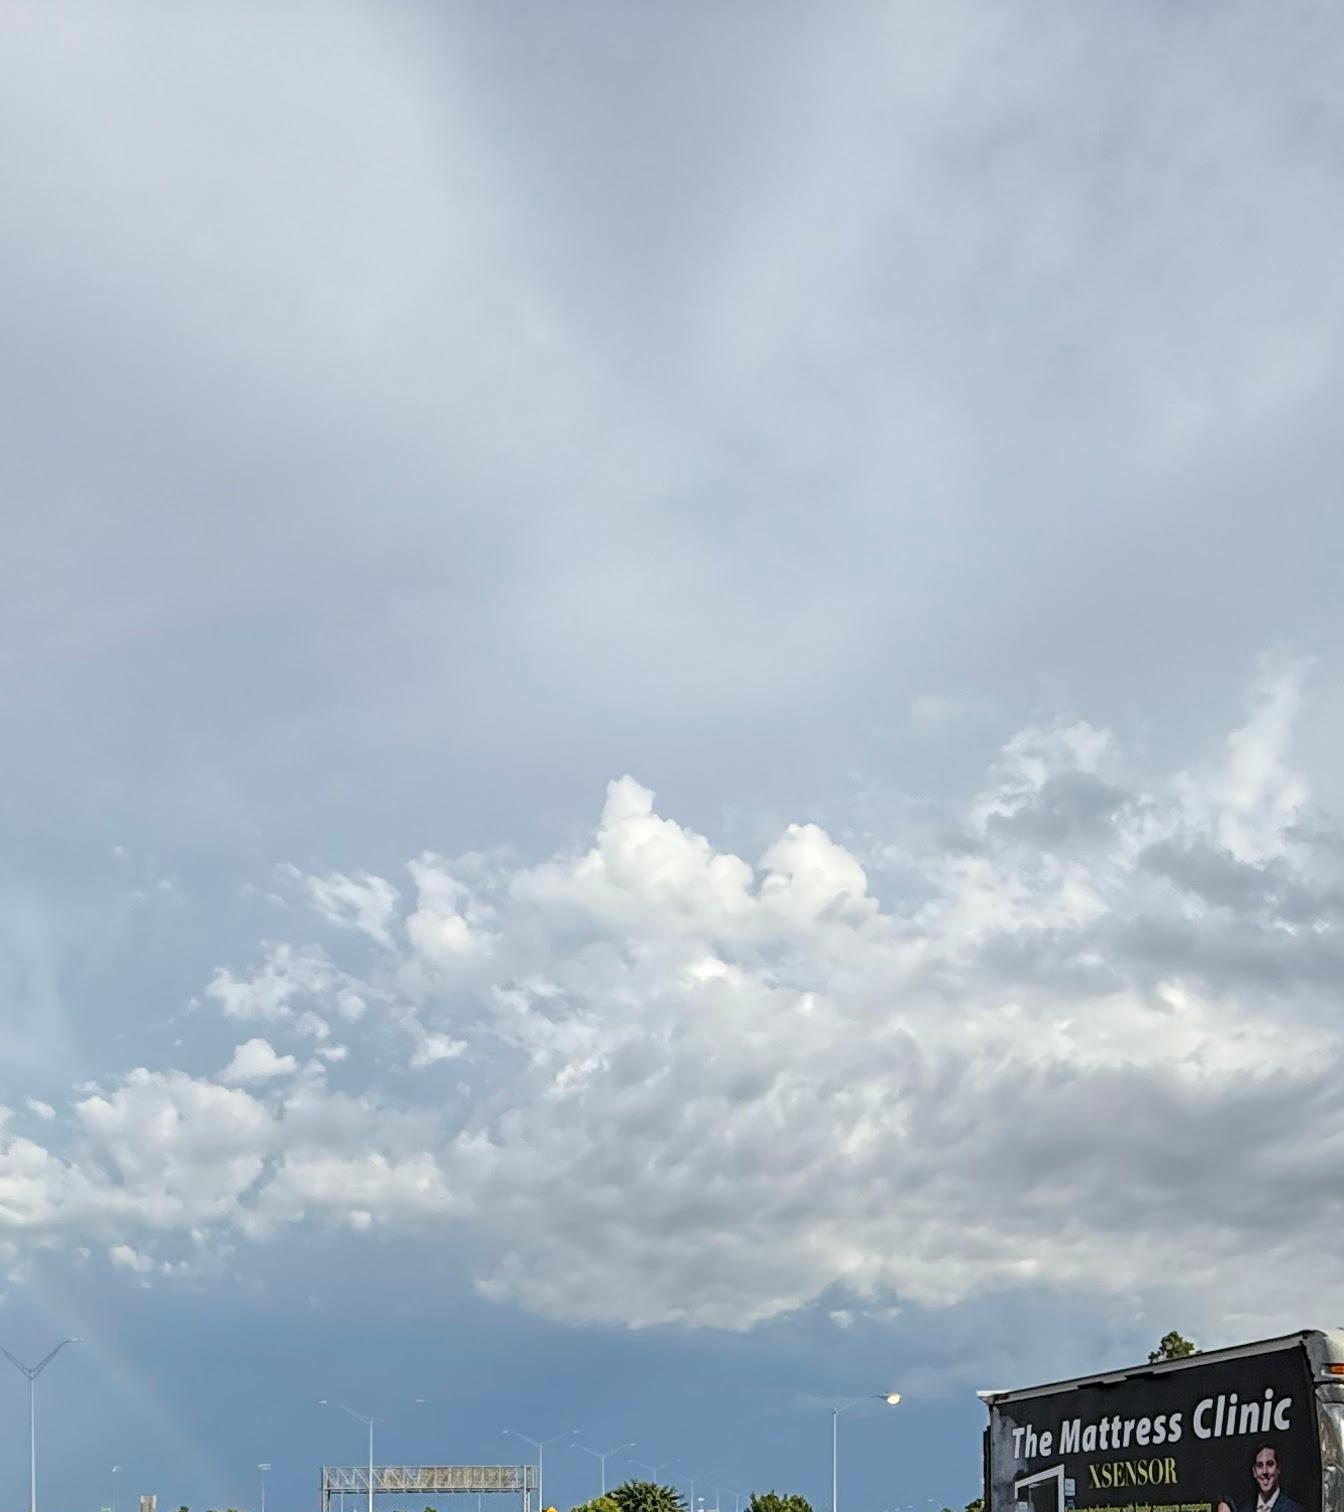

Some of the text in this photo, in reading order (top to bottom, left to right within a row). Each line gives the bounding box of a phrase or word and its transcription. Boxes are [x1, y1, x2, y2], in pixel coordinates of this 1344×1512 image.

[1011, 1388, 1293, 1459] The Mattress Clinic
[1088, 1457, 1178, 1489] XSENSOR
